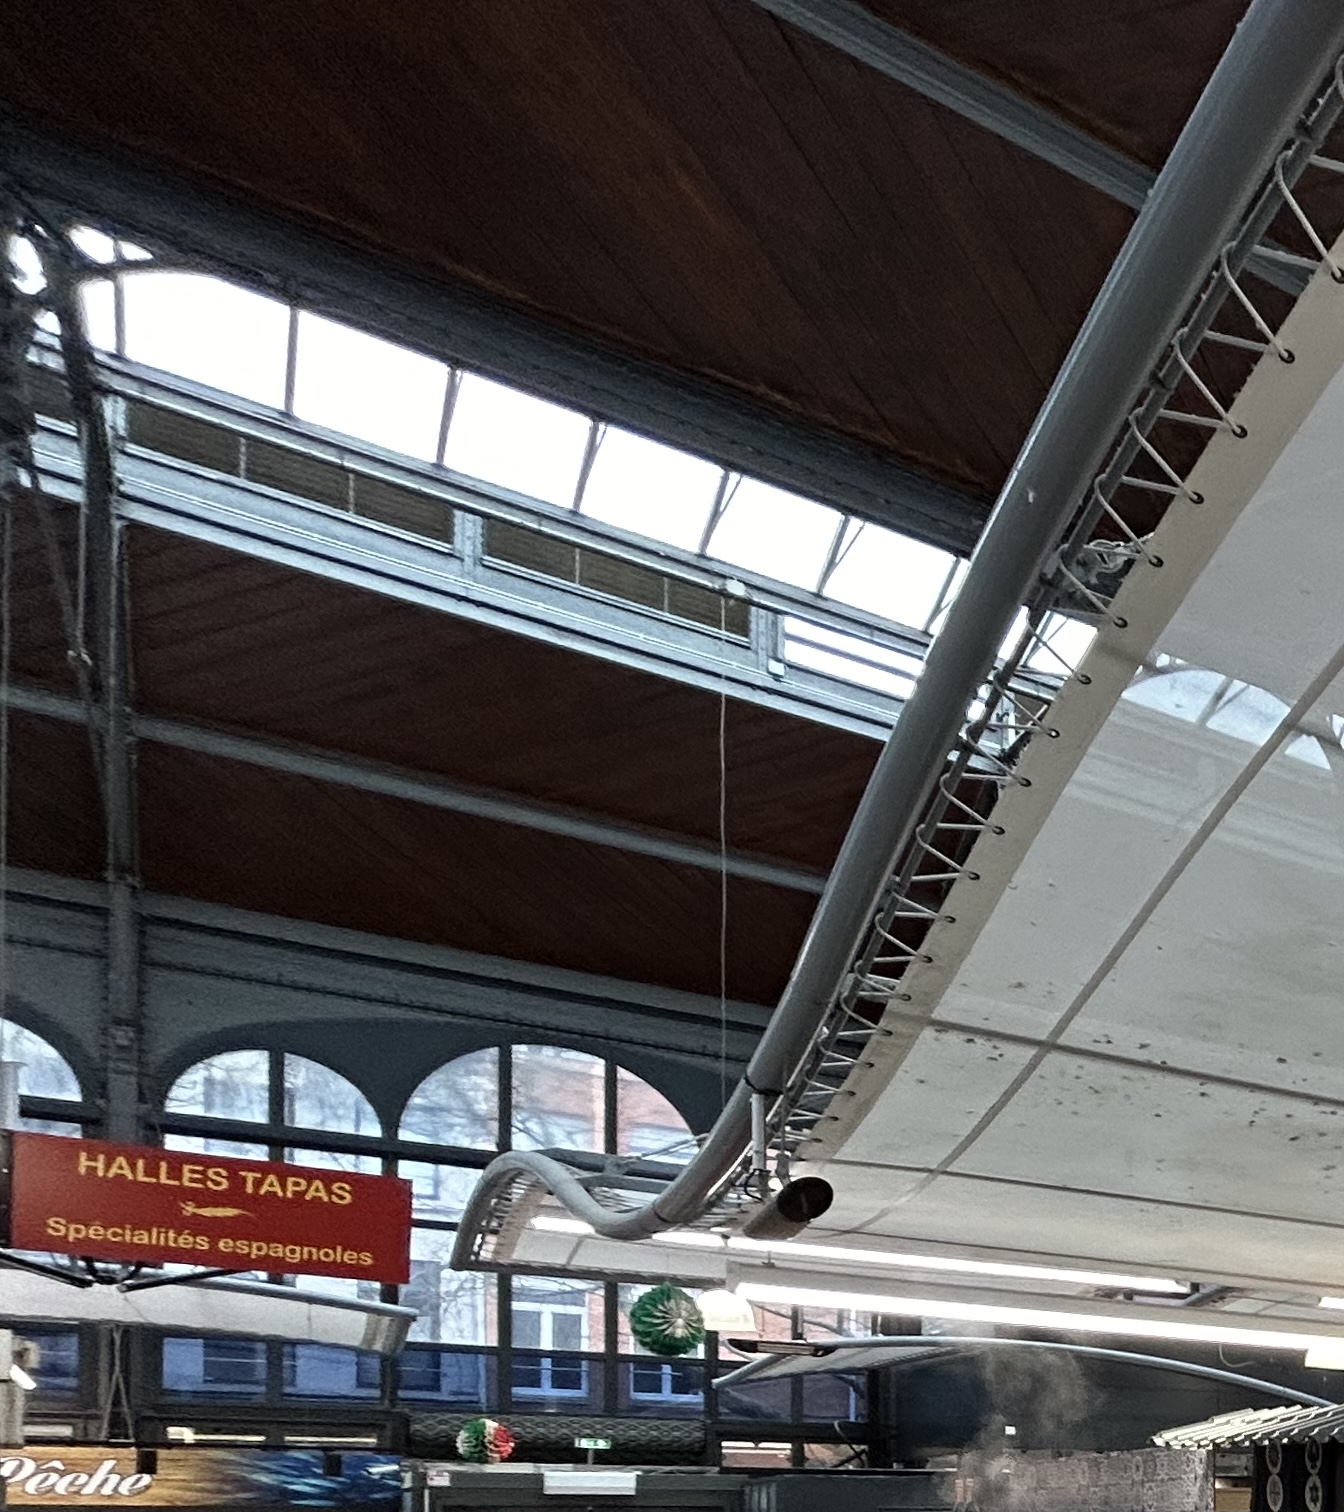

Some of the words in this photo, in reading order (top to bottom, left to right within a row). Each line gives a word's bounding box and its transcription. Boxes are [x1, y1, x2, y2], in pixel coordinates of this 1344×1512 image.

[78, 1151, 228, 1191] HALLES
[239, 1171, 353, 1205] TAPAS
[47, 1217, 210, 1251] Spécialités
[218, 1237, 374, 1267] espagnoles
